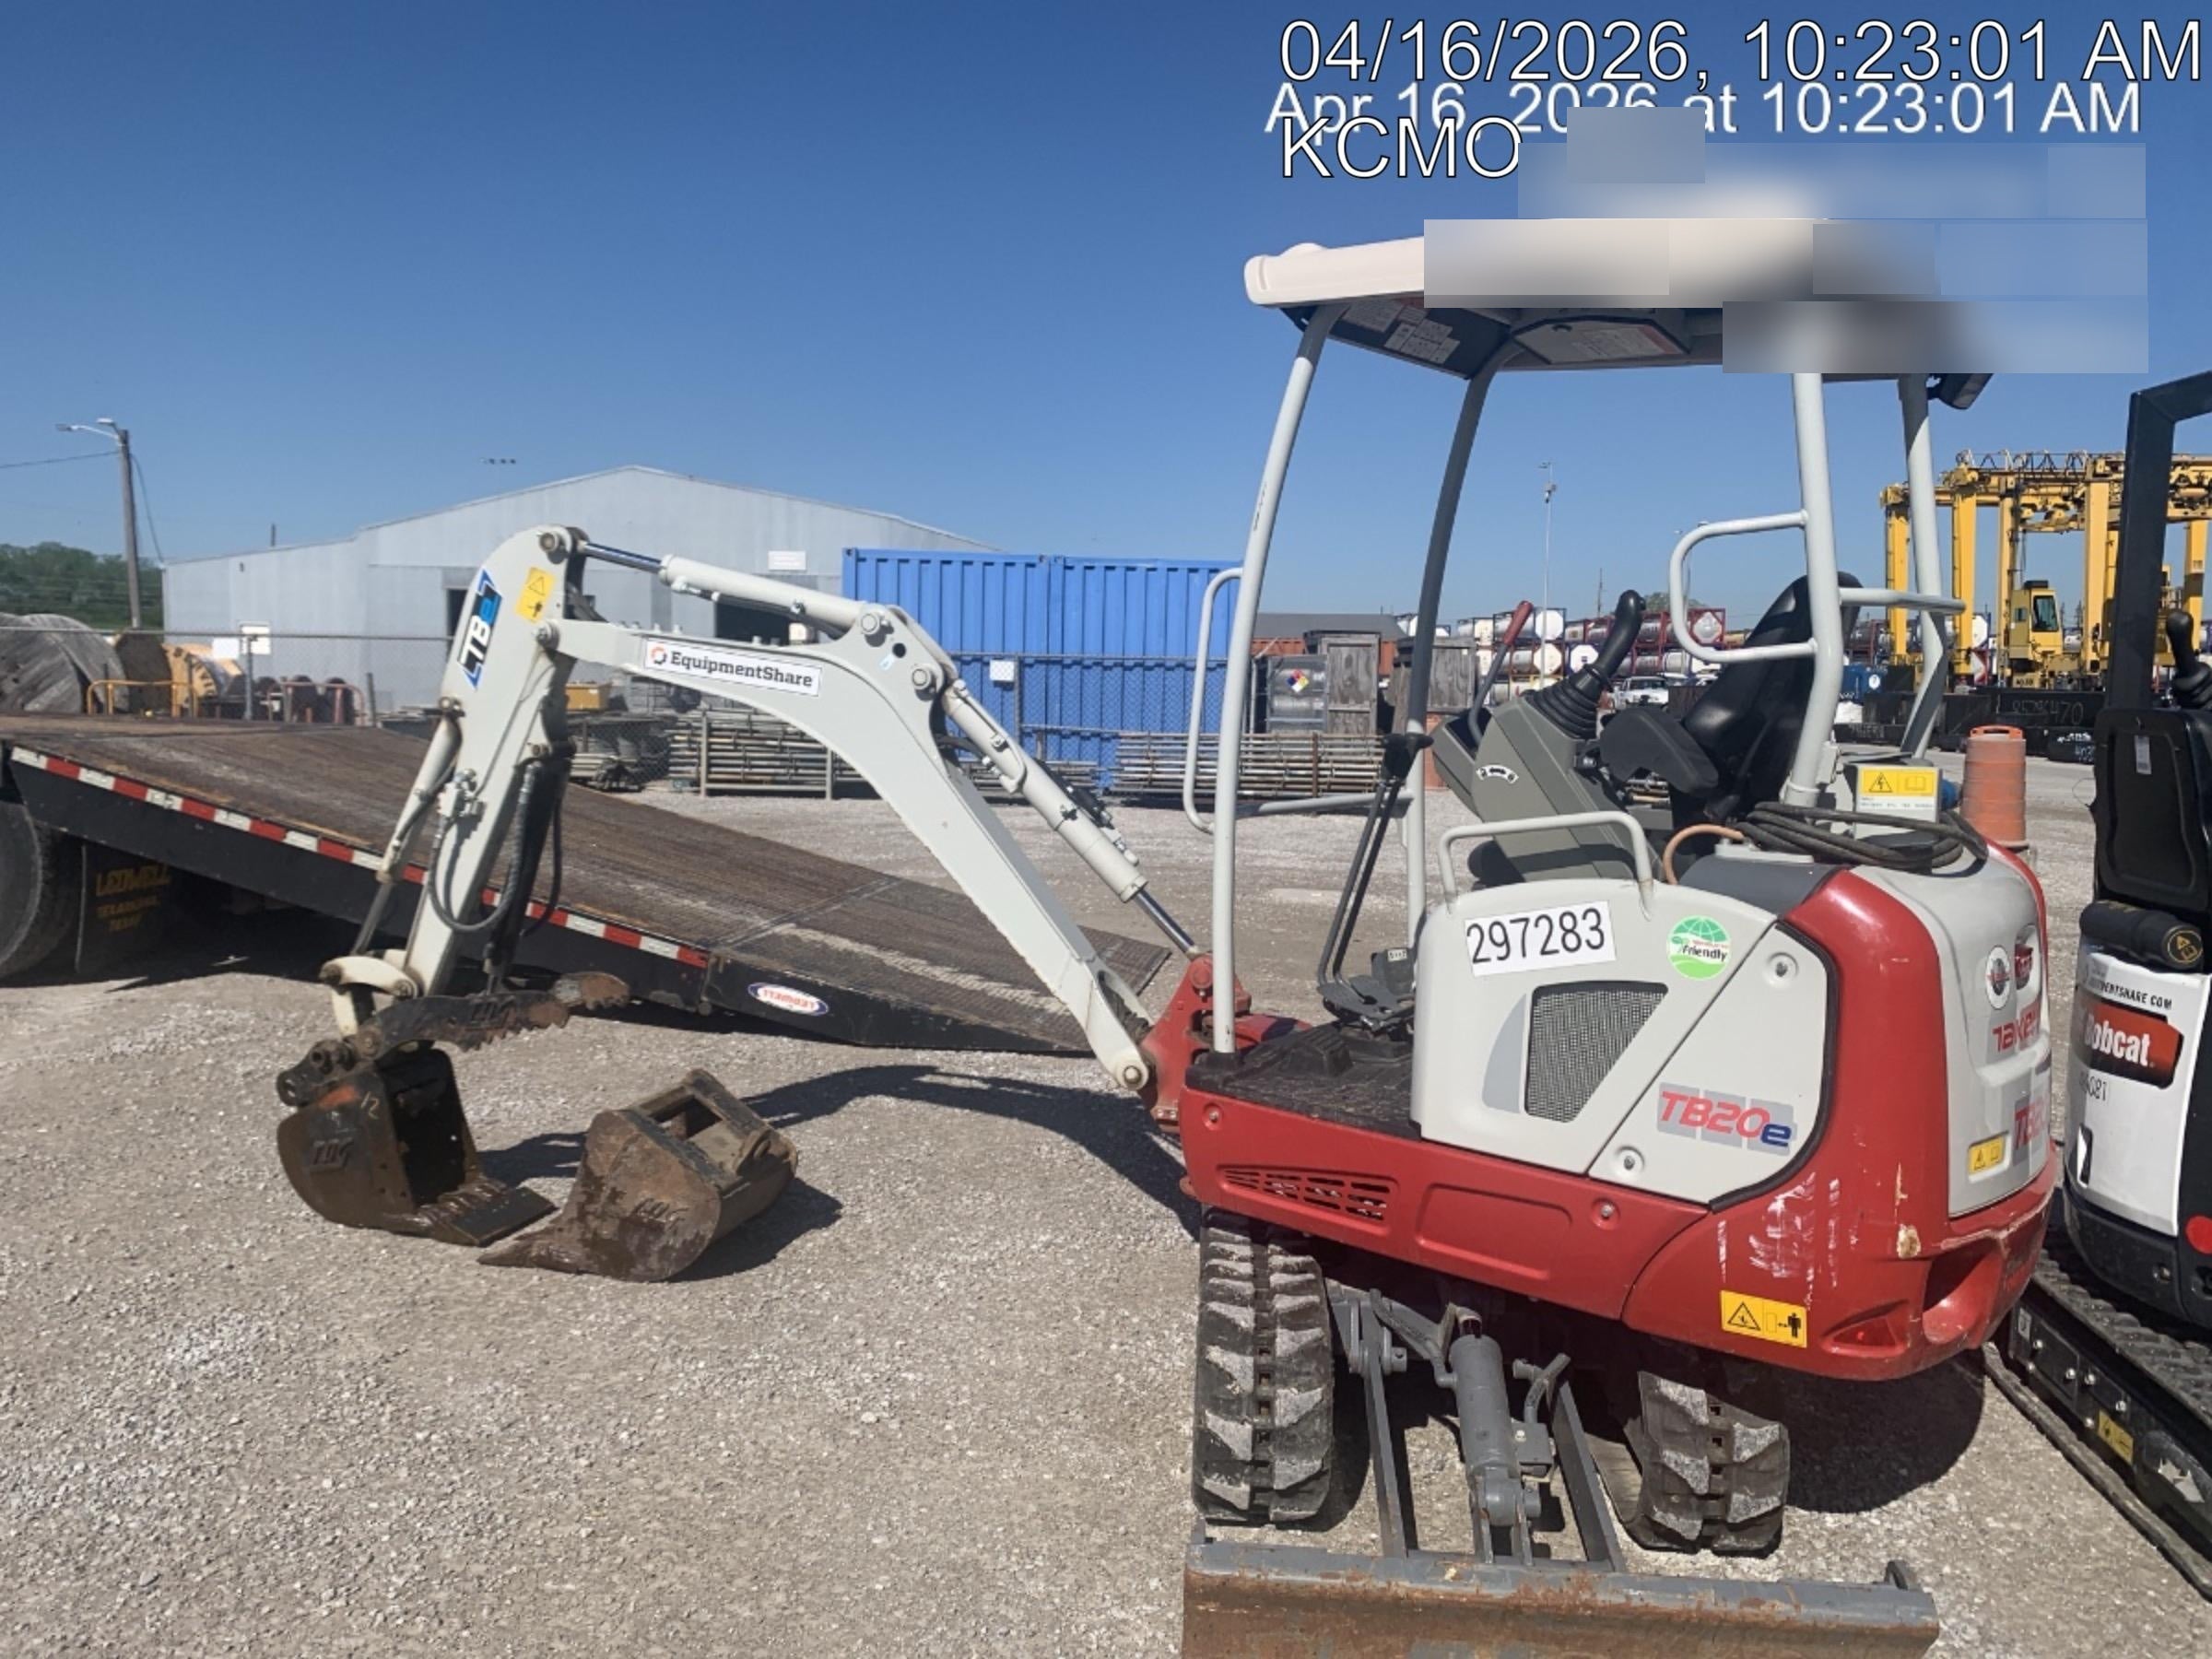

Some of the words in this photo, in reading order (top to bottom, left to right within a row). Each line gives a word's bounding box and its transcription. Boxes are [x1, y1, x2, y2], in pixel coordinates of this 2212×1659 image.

[671, 651, 812, 687] EquipmentShare
[1466, 907, 1606, 964] 297283
[2084, 1011, 2151, 1067] Bobcat
[1661, 1091, 1792, 1147] TB20e
